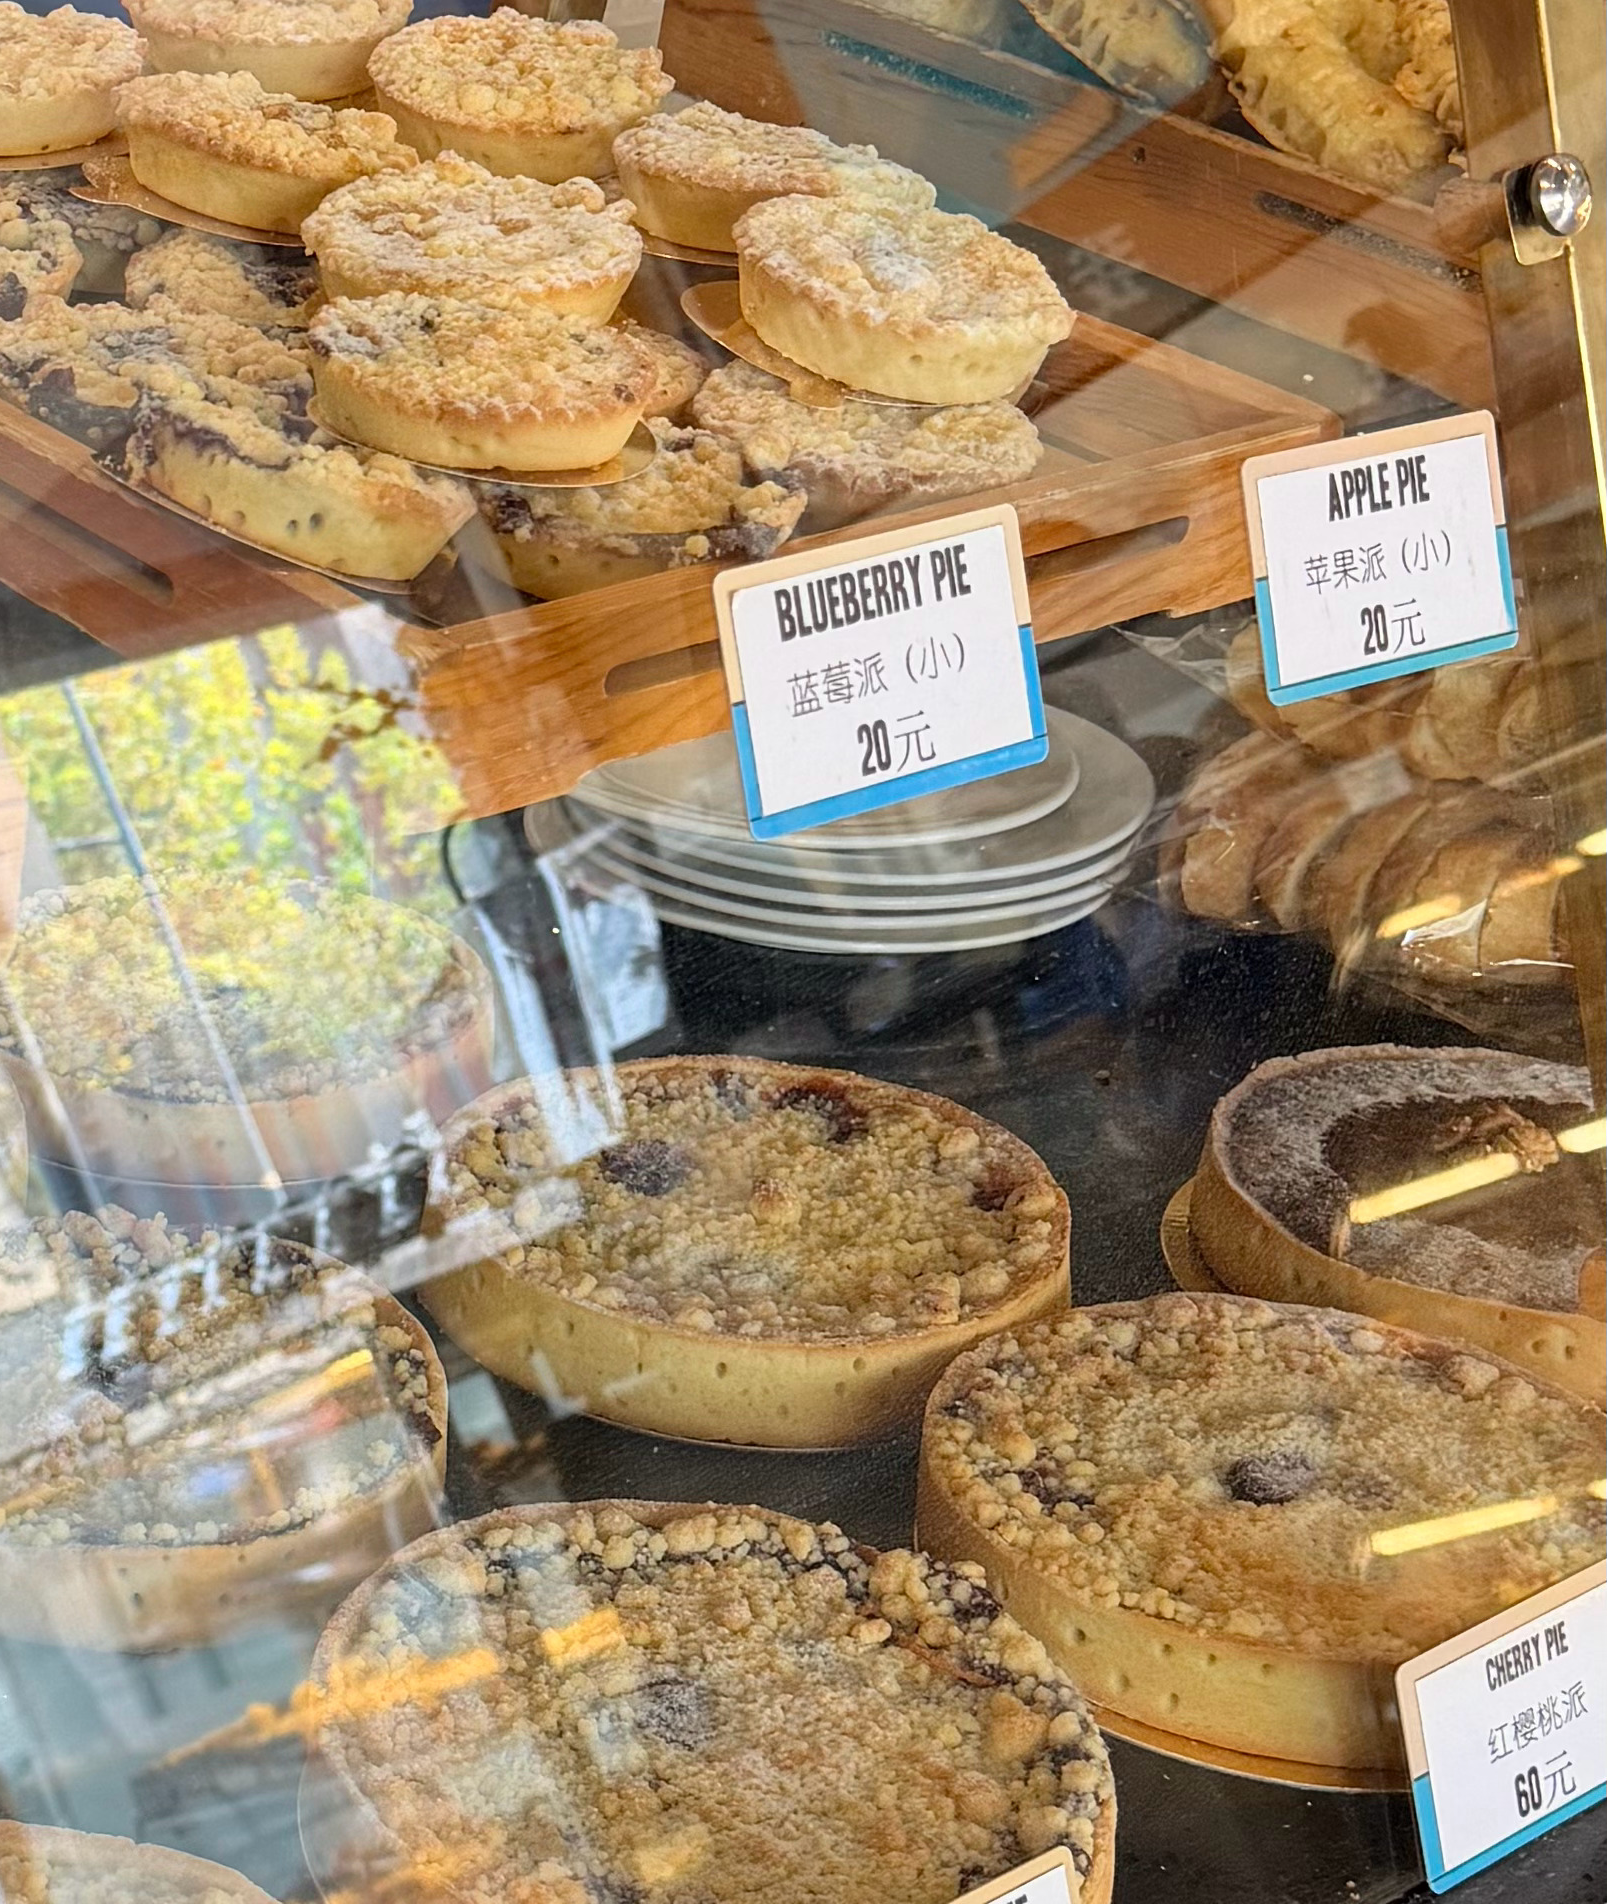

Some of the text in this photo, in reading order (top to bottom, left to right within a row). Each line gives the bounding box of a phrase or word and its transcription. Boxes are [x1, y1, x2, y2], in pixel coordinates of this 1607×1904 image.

[1329, 455, 1430, 521] APPLE PIE
[775, 544, 971, 643] BLUEBERRY PIE
[1359, 599, 1427, 655] 20元
[857, 710, 937, 776] 20元
[1486, 1622, 1570, 1691] CHERRY PIE
[1487, 1681, 1589, 1764] 红樱桃派
[1514, 1753, 1579, 1818] 60元
